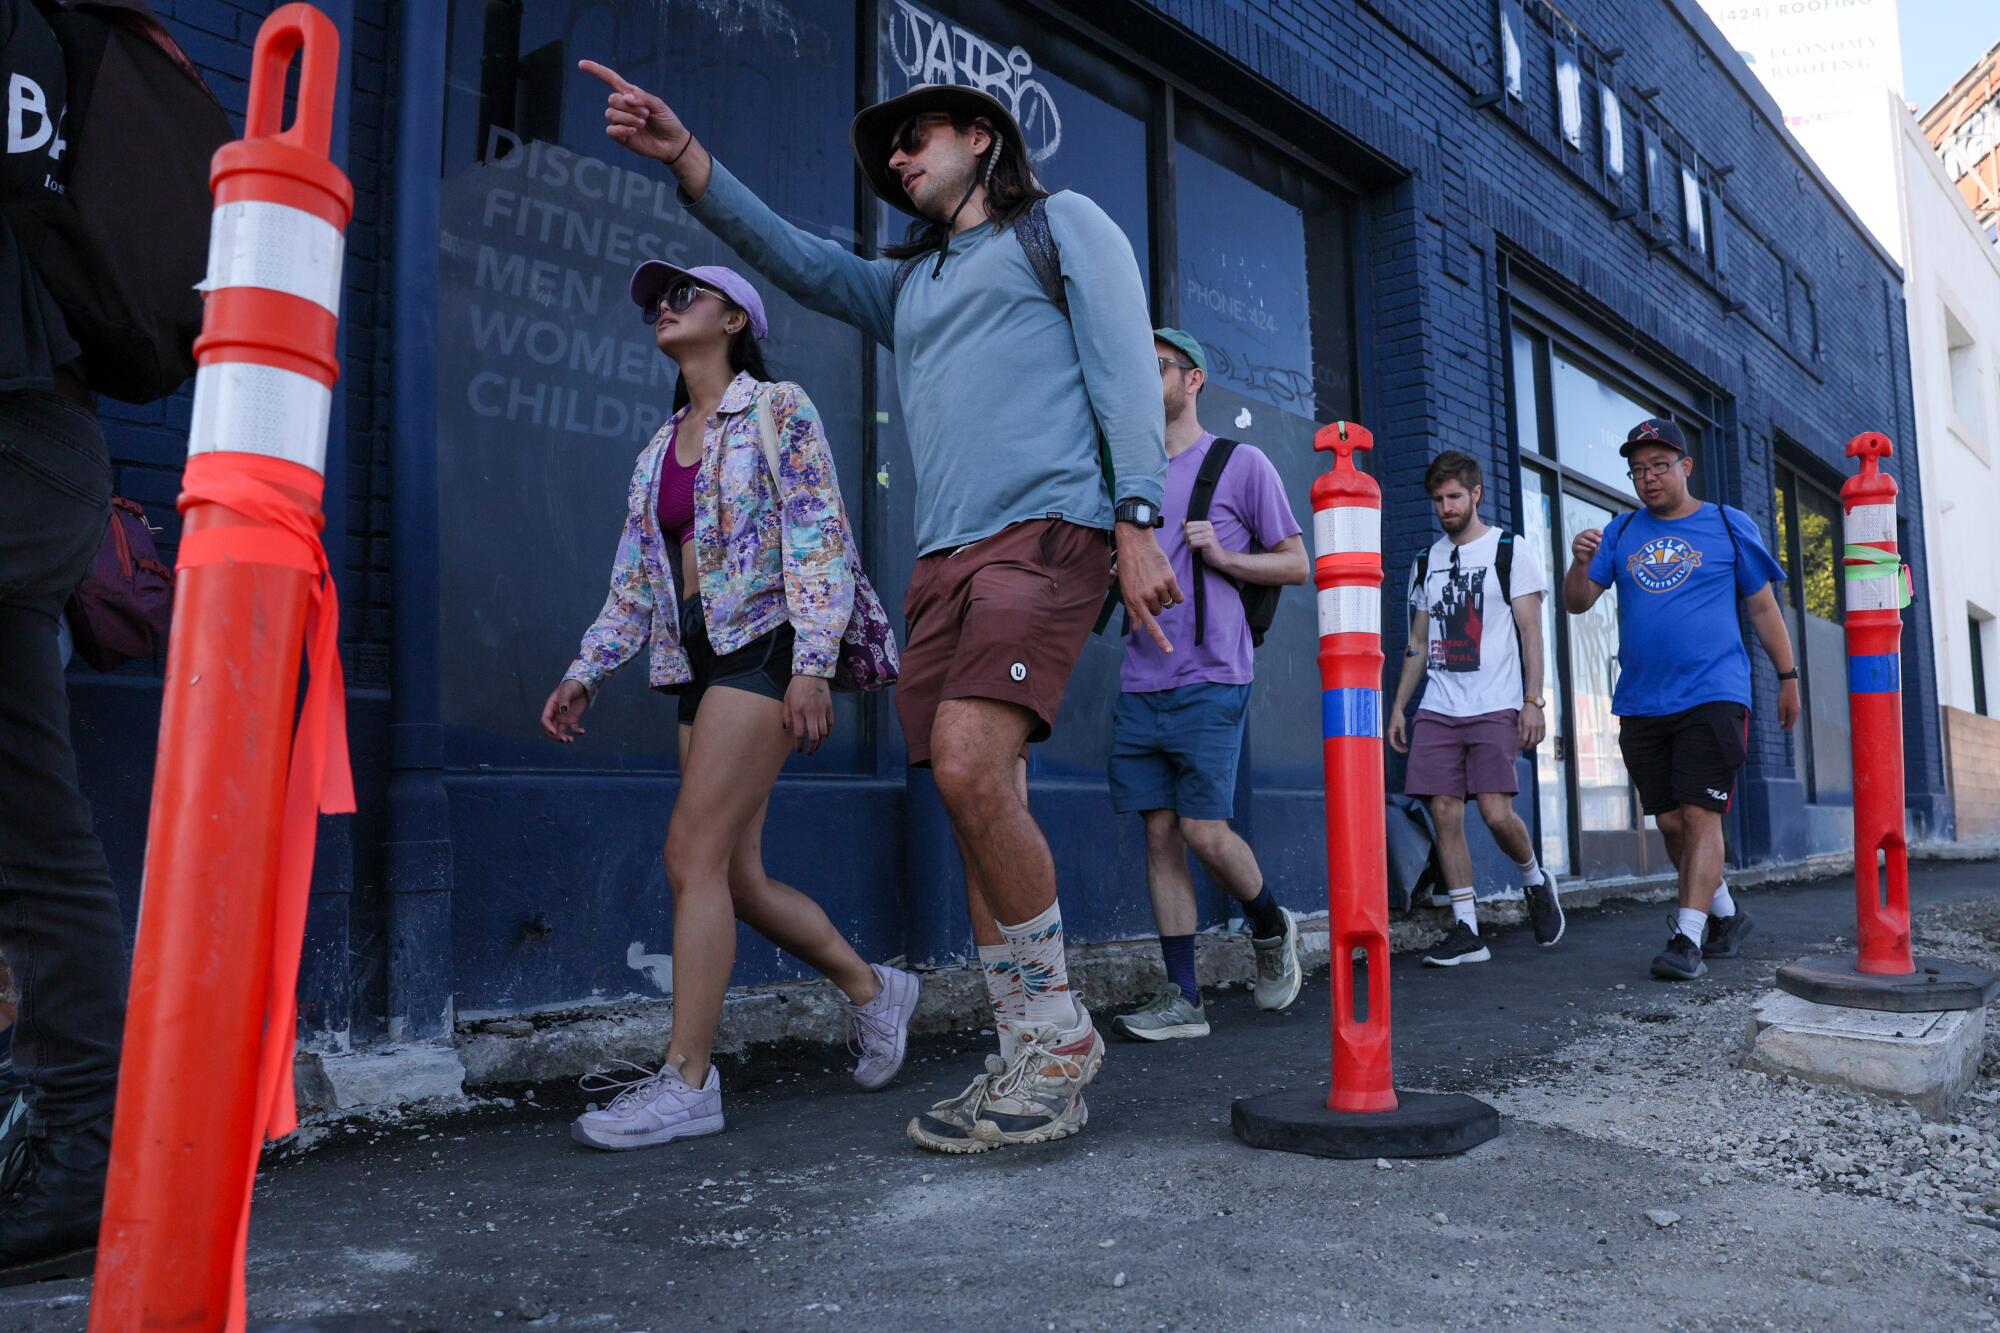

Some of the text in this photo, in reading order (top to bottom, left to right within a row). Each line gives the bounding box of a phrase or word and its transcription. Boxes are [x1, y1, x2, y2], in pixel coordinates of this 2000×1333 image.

[1769, 36, 1878, 60] ECONOMY
[1771, 57, 1872, 79] ROOFING
[483, 188, 688, 267] FITNESS
[475, 246, 602, 316] MEN
[1645, 539, 1685, 554] UCLA
[1637, 568, 1686, 589] BASKETBALL
